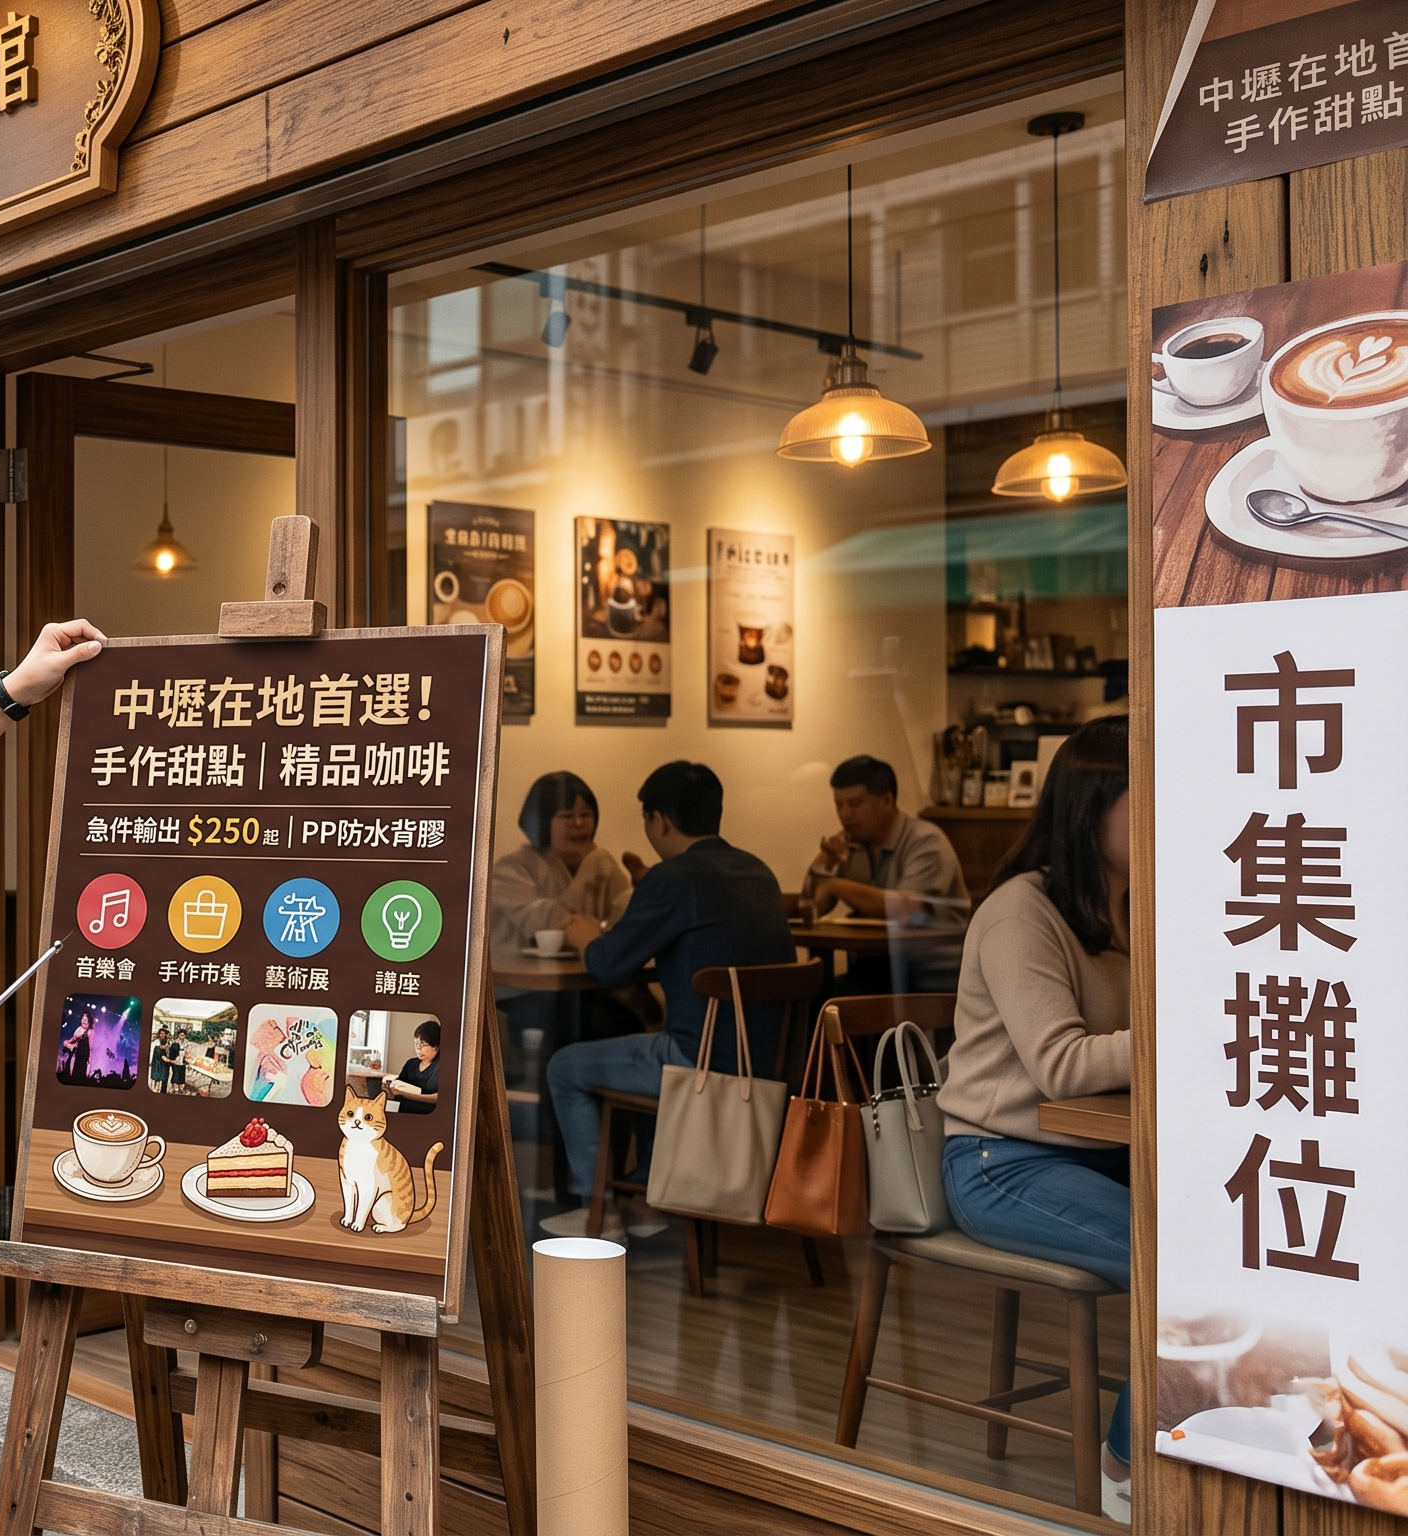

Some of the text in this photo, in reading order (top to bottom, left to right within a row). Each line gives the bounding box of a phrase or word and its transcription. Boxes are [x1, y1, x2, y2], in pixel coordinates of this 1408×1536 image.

[1225, 81, 1405, 153] 手作甜點
[112, 673, 434, 730] 中壢在地首選!
[85, 815, 180, 845] 急件輸出
[302, 818, 446, 849] PP防水背膠
[76, 956, 136, 982] 音樂會
[158, 960, 241, 987] 手作市集
[265, 965, 330, 991] 藝術展
[1222, 650, 1360, 1282] 市集攤位
[375, 970, 421, 996] 講座
